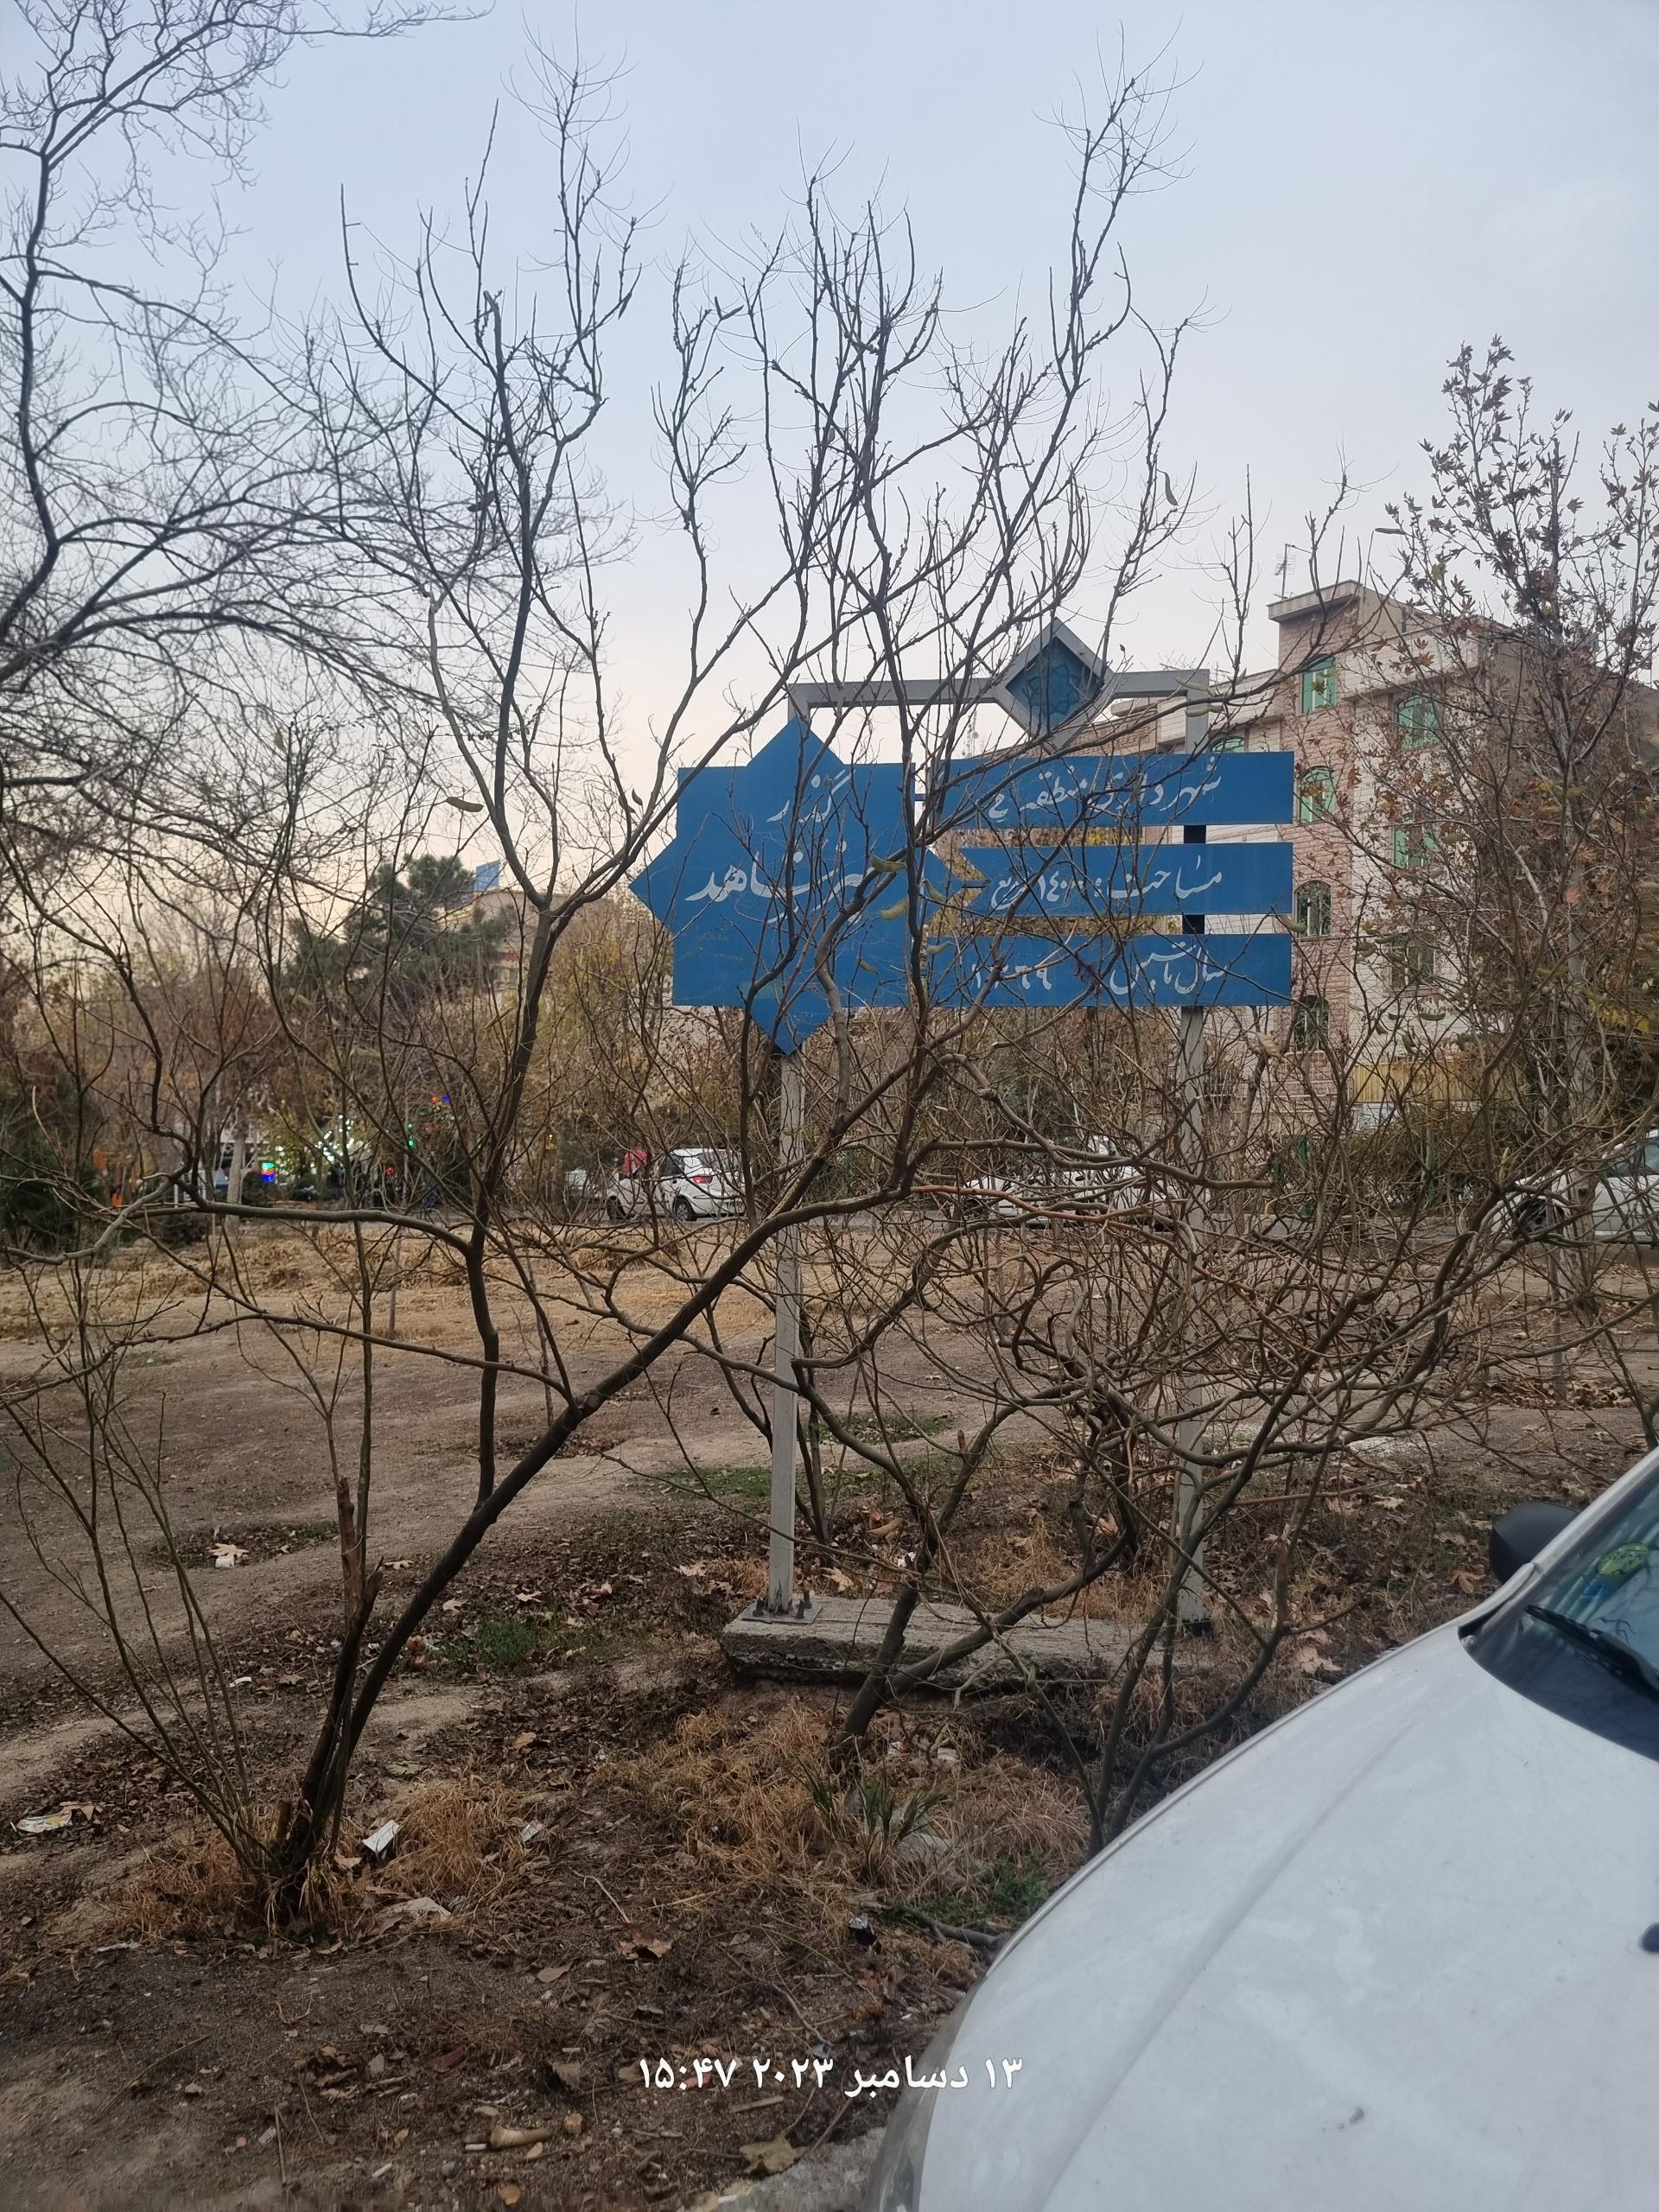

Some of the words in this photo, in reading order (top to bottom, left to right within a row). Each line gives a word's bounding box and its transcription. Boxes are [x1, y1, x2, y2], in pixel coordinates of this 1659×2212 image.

[1020, 765, 1088, 811] منطقه
[685, 839, 840, 903] شاهد
[1174, 944, 1228, 995] سال
